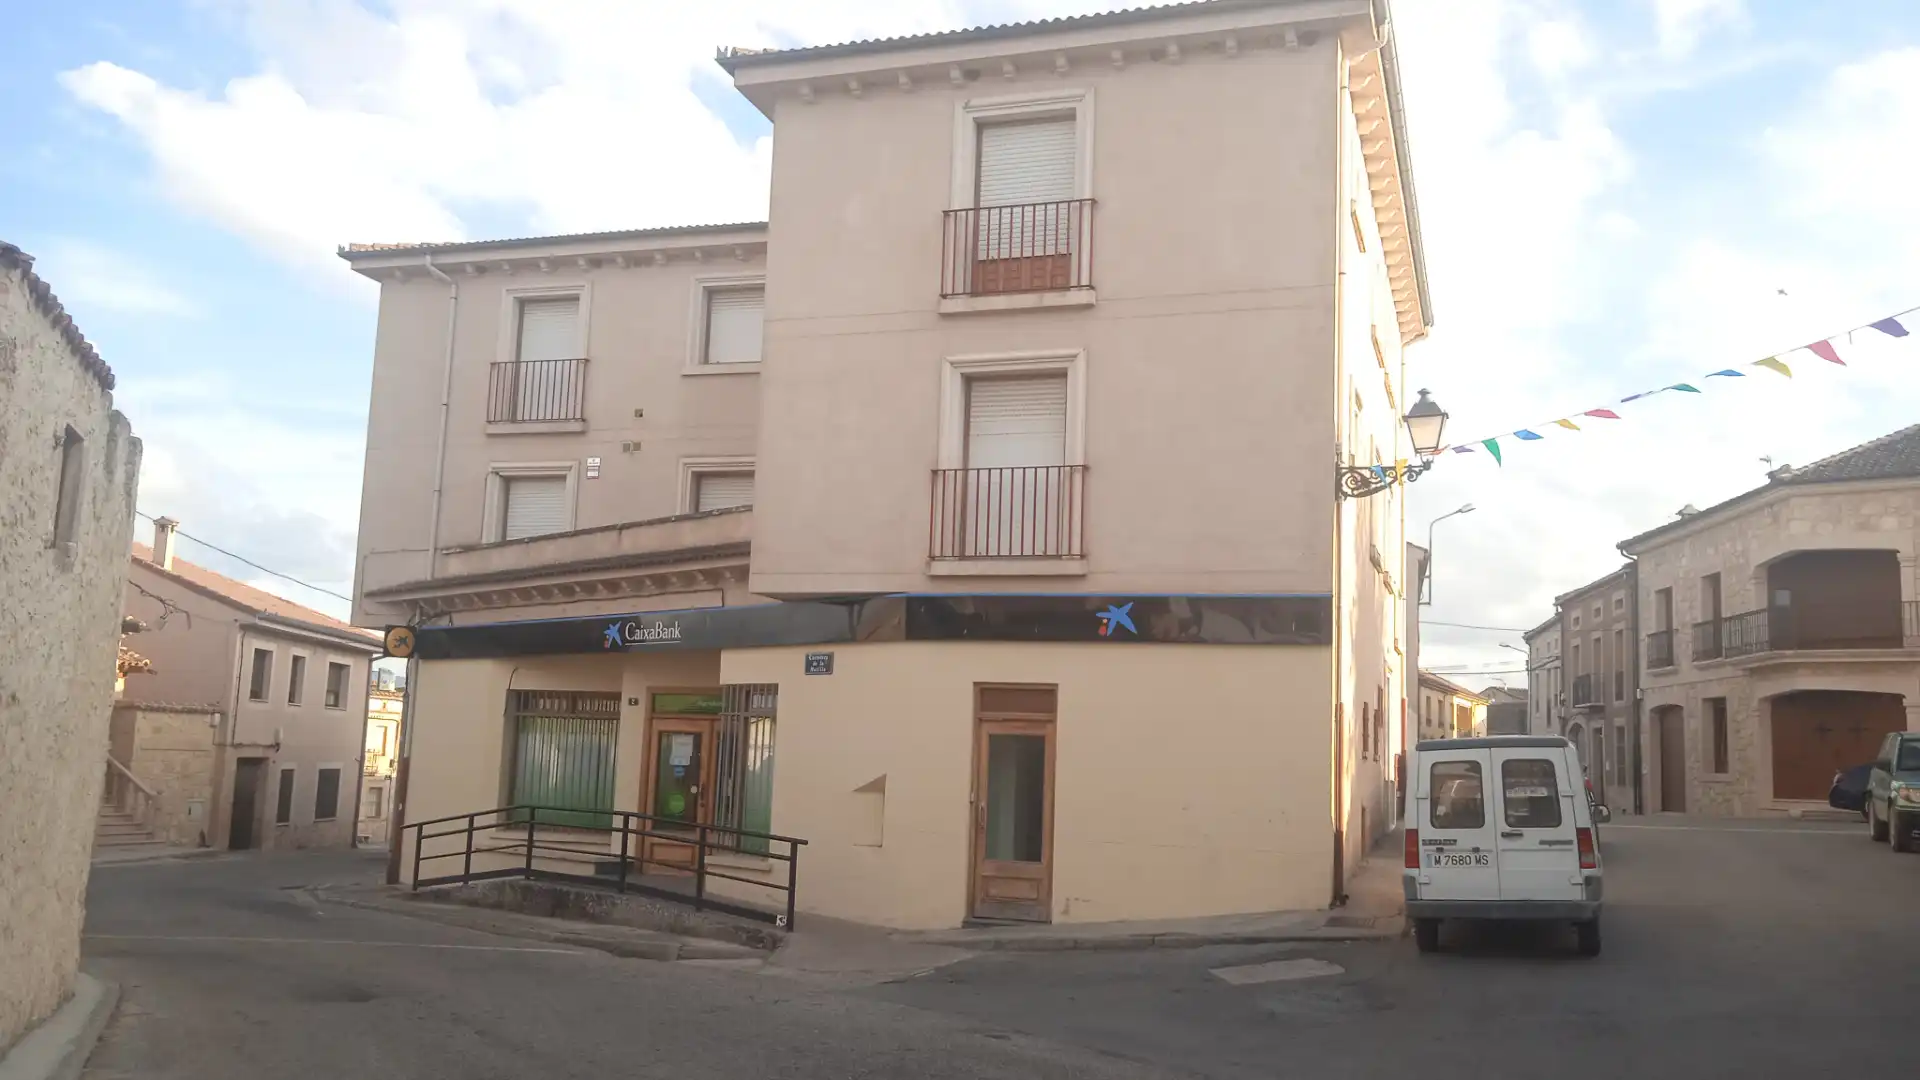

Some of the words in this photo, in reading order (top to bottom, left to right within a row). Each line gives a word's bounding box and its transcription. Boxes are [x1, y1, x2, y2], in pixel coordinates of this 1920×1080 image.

[625, 621, 681, 640] CaixaBank
[1434, 855, 1441, 866] M
[1444, 855, 1471, 866] 7680
[1474, 855, 1489, 866] MS
